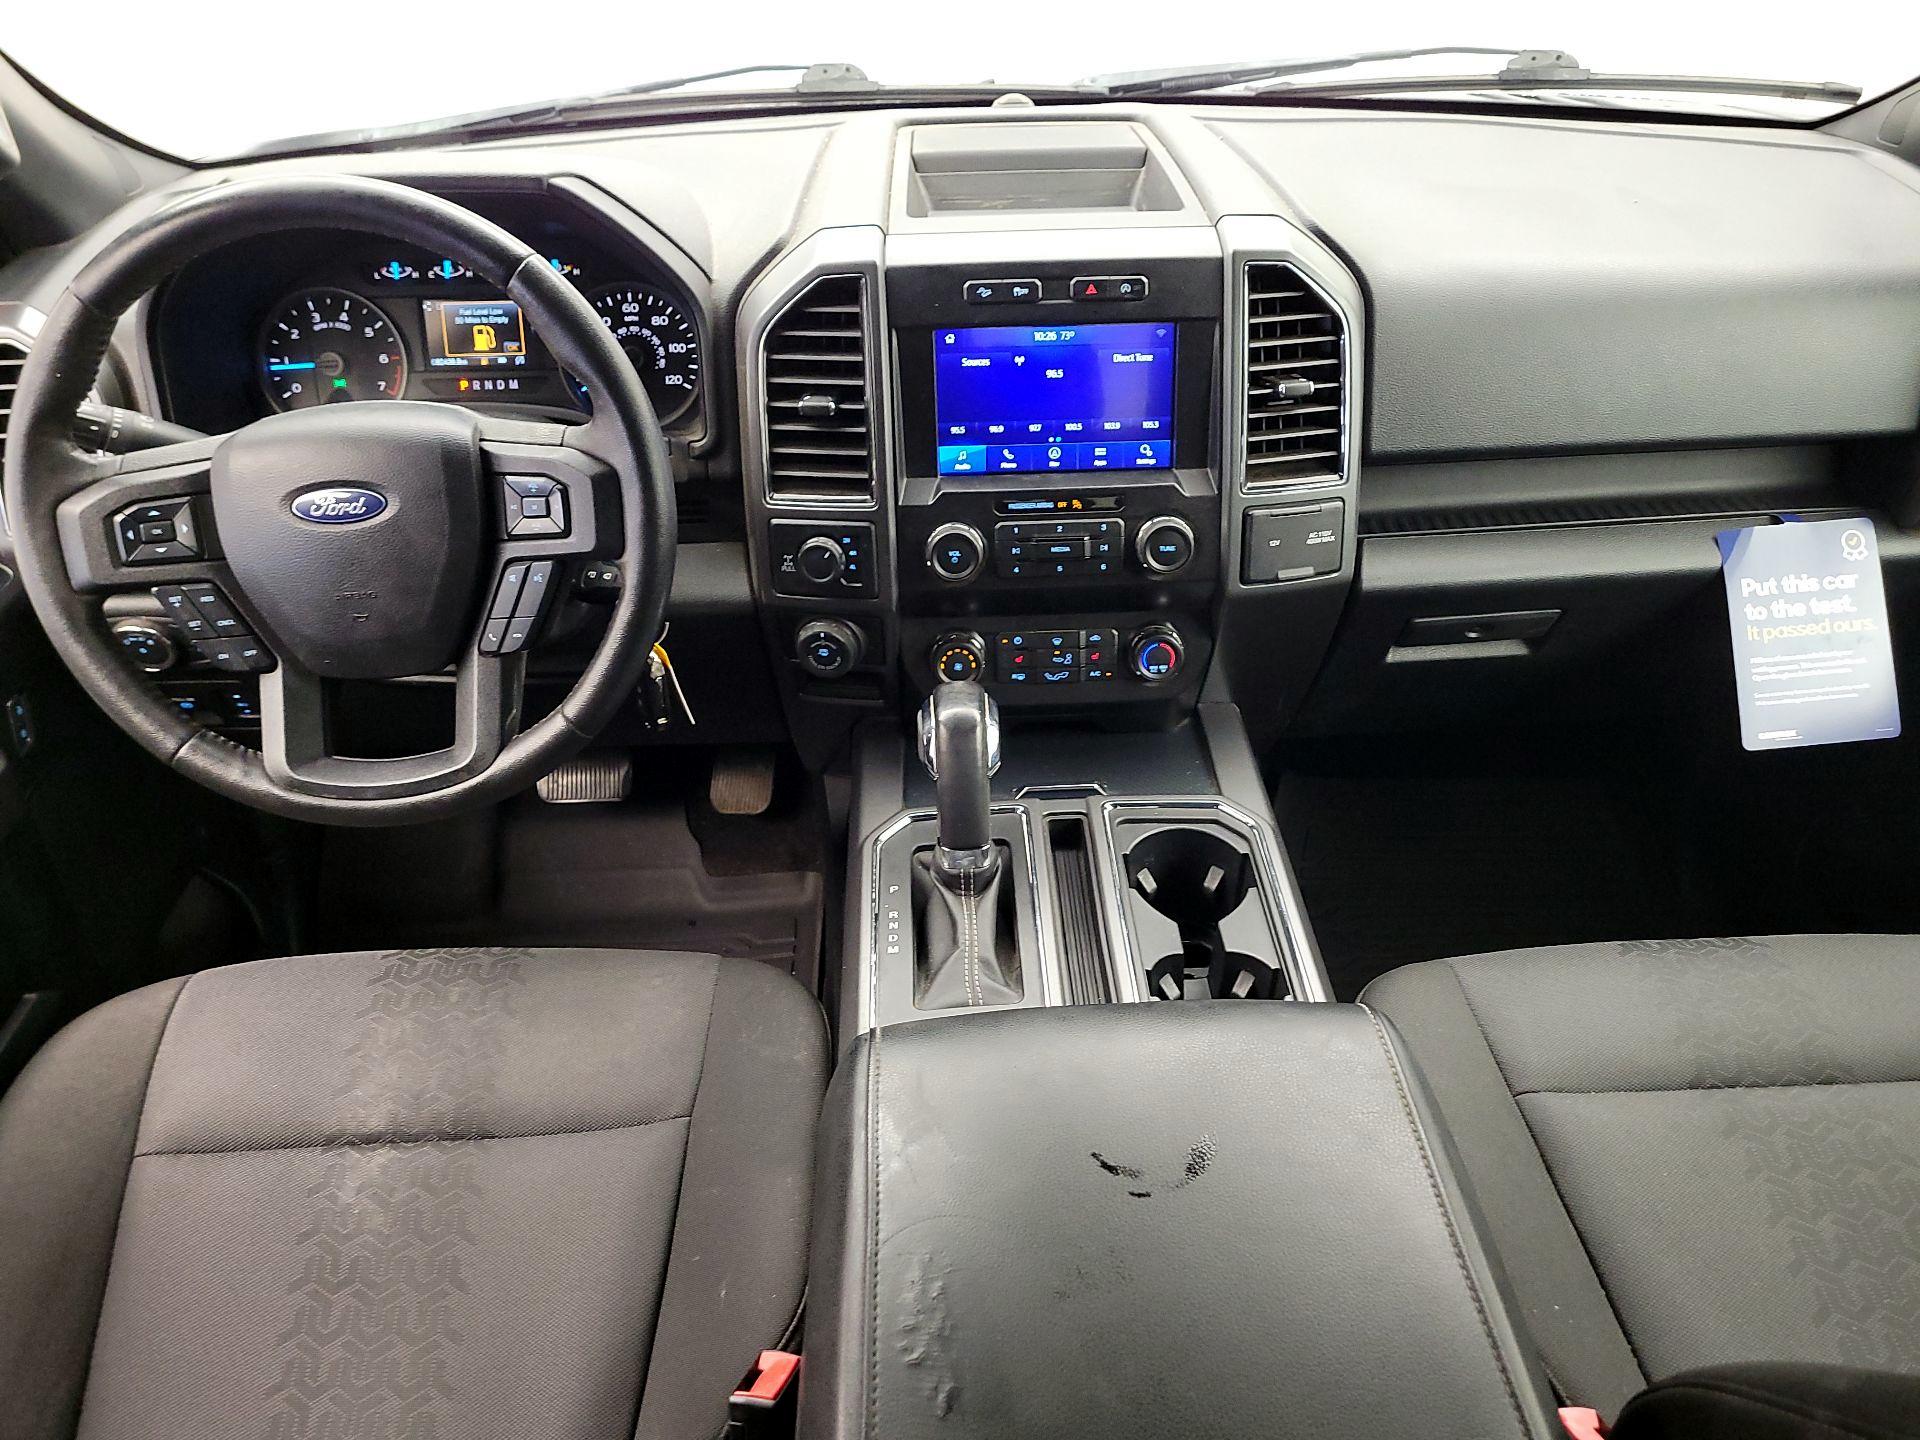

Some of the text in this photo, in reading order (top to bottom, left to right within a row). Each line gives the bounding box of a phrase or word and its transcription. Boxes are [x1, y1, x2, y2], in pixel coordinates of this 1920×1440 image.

[622, 303, 639, 313] 60
[311, 312, 320, 323] 3
[339, 311, 349, 321] 4
[651, 315, 669, 326] 80
[290, 329, 300, 340] 2
[364, 327, 375, 338] 5
[1033, 331, 1058, 342] 10:26
[668, 342, 687, 353] 100
[378, 353, 389, 364] 6
[961, 357, 991, 367] Sources
[1136, 353, 1154, 362] Tune
[508, 379, 519, 390] M
[665, 374, 683, 385] 120
[290, 382, 302, 394] 0
[377, 380, 386, 391] 7
[309, 495, 368, 516] Ford
[1740, 573, 1860, 597] Put this car
[1744, 594, 1858, 621] to the test.
[1747, 617, 1879, 644] It passed ours.
[889, 885, 899, 894] P
[888, 911, 899, 919] R
[888, 921, 899, 930] N
[888, 934, 899, 942] D
[887, 945, 900, 954] M
